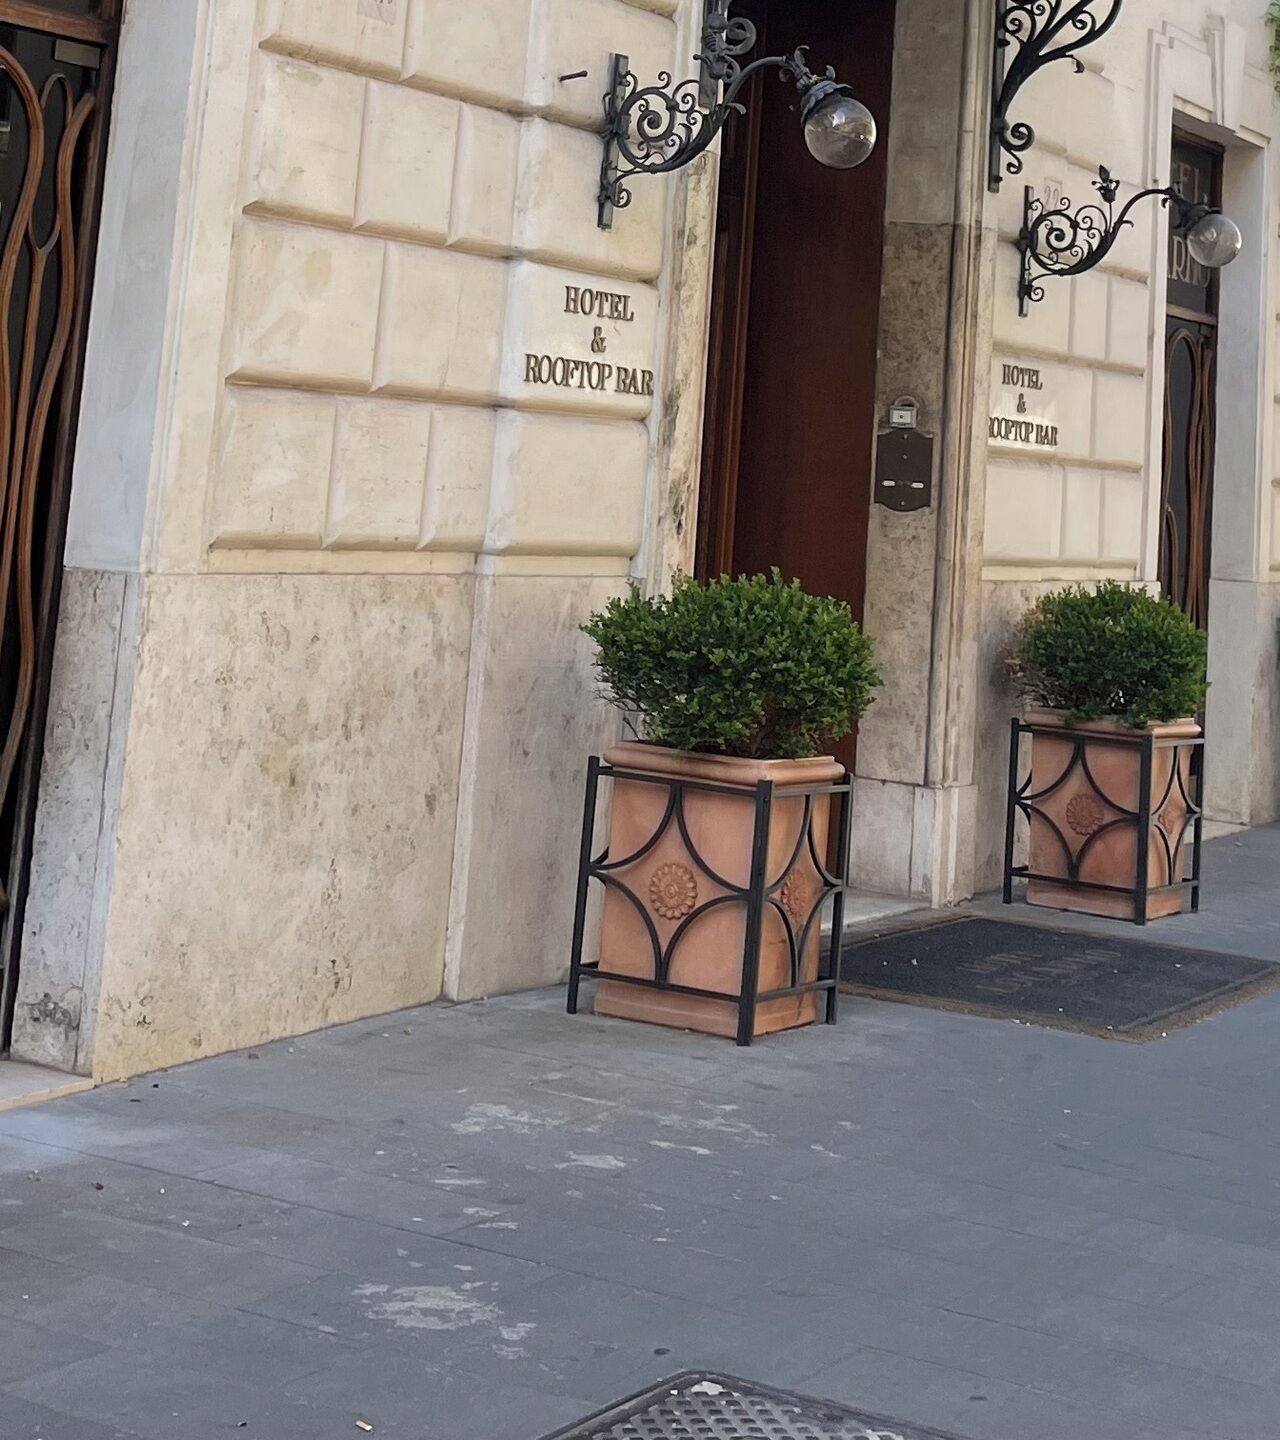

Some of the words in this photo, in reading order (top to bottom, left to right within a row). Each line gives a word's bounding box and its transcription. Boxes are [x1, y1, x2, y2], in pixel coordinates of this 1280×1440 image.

[564, 285, 634, 322] HOTEL
[590, 326, 607, 353] &
[524, 353, 613, 391] ROOFTOP
[614, 366, 654, 396] BAR
[1001, 363, 1043, 391] HOTEL
[1016, 393, 1027, 413] &
[1035, 423, 1058, 446] BAR
